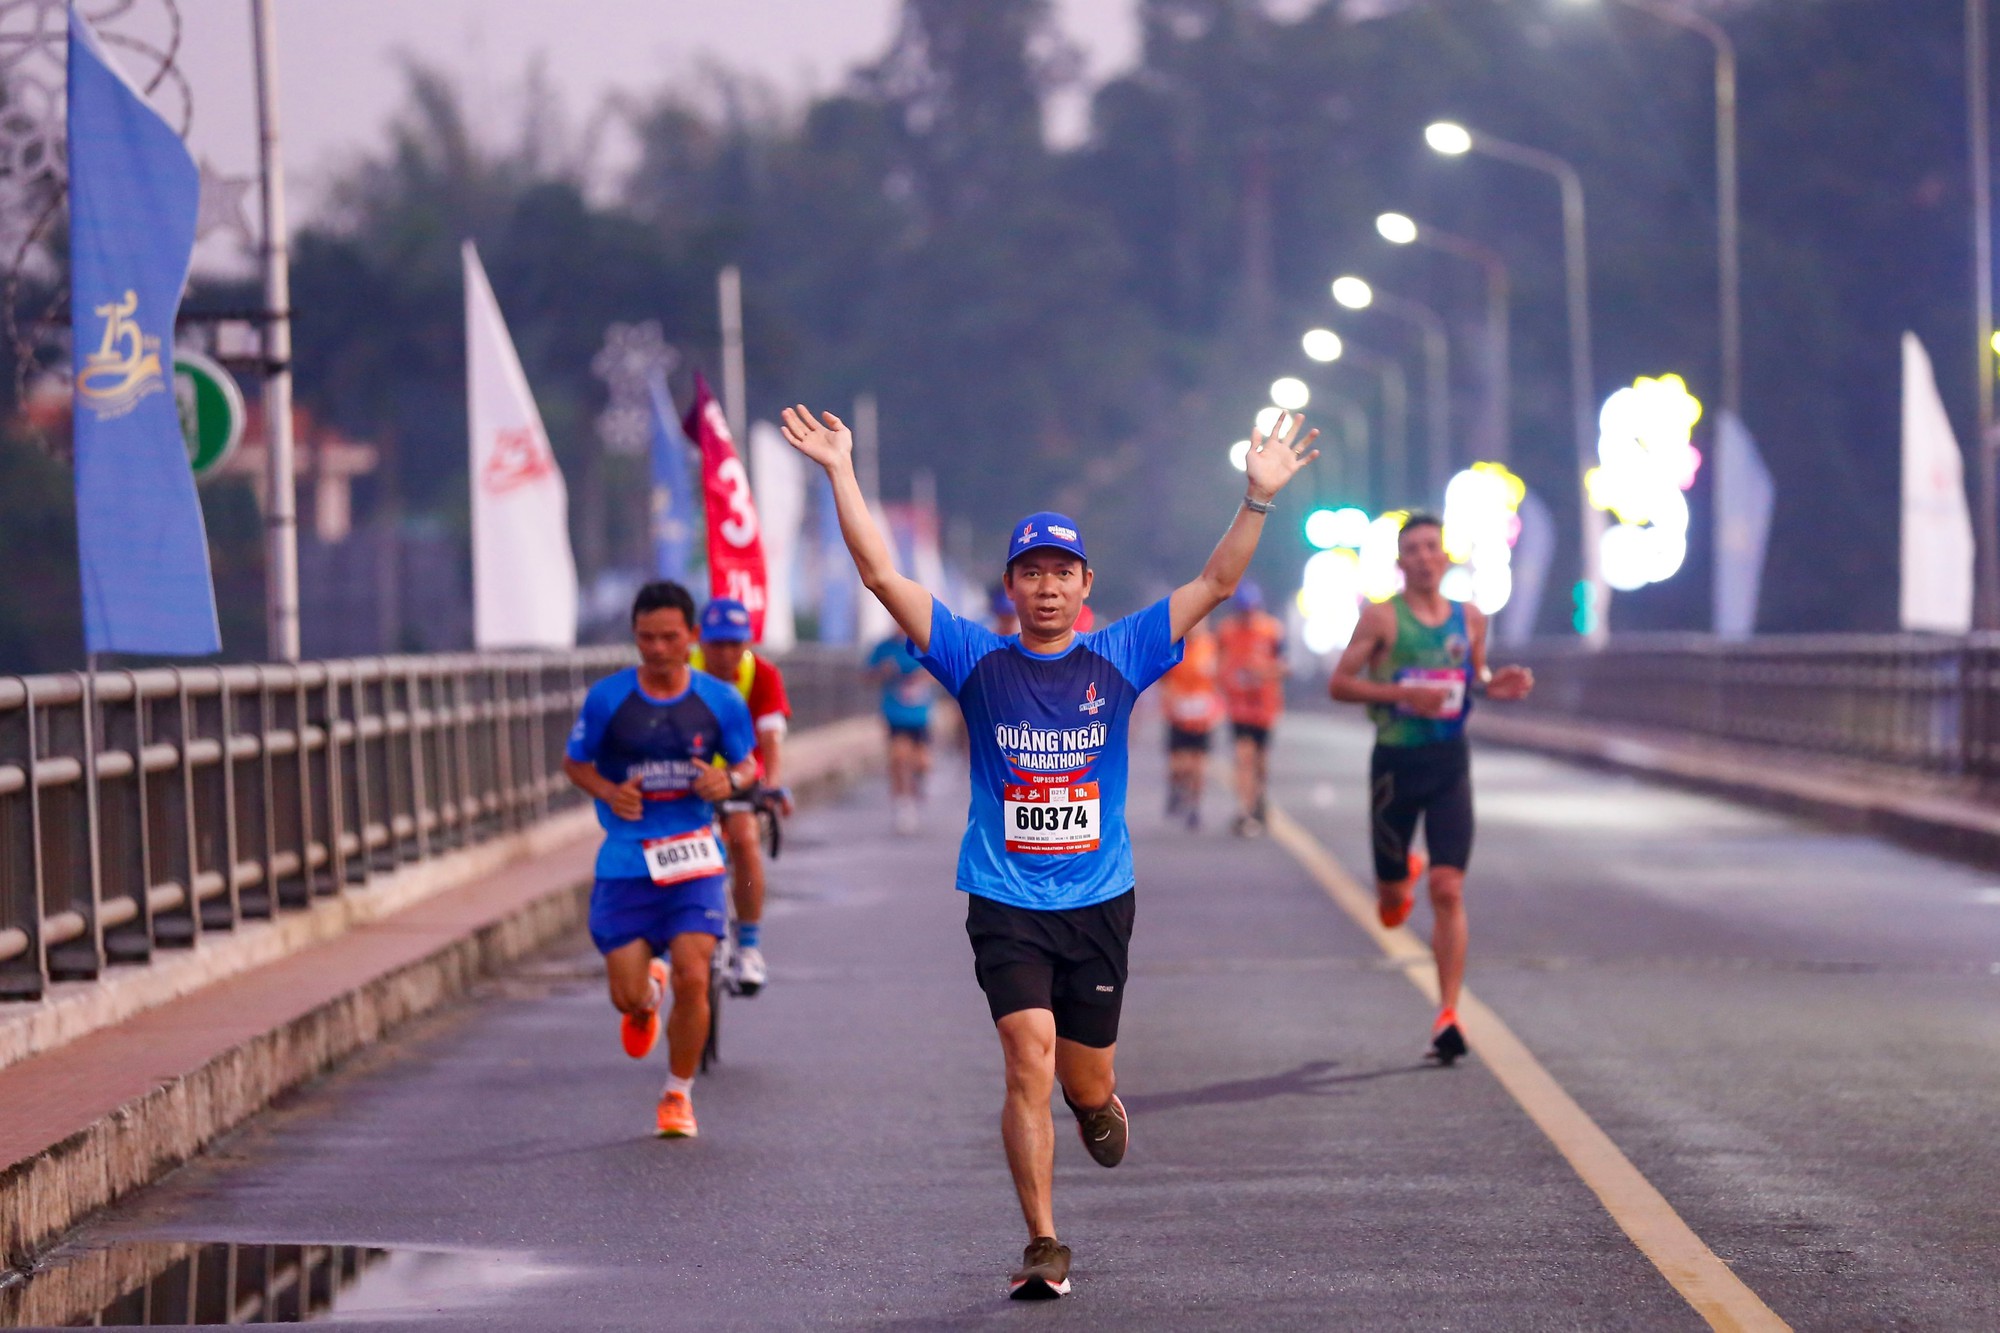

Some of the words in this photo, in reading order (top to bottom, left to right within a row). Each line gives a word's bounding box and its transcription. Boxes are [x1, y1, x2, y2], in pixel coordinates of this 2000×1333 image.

[997, 721, 1061, 752] QUẢNG
[1062, 721, 1106, 751] NGÃI
[1019, 752, 1085, 770] MARATHON
[1055, 775, 1069, 783] 2023
[1016, 805, 1088, 831] 60374
